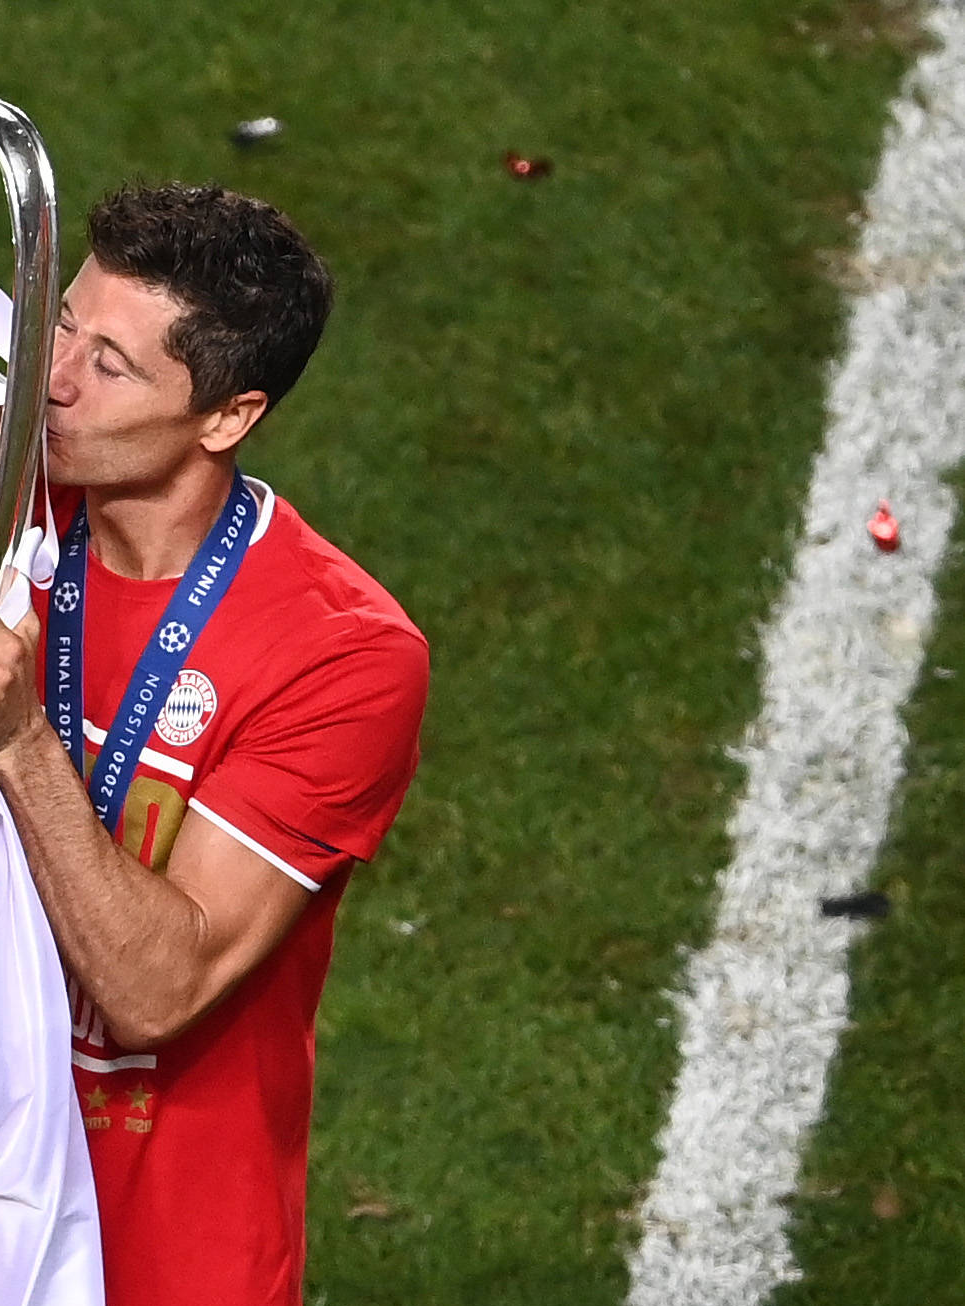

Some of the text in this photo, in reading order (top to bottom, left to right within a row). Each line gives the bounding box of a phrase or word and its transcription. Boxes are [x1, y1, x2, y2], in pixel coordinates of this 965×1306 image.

[188, 504, 247, 607] FINAL 2020
[58, 636, 71, 694] FINAL
[179, 674, 214, 712] BAYERN
[100, 751, 126, 798] 2020
[119, 673, 161, 746] LISBON
